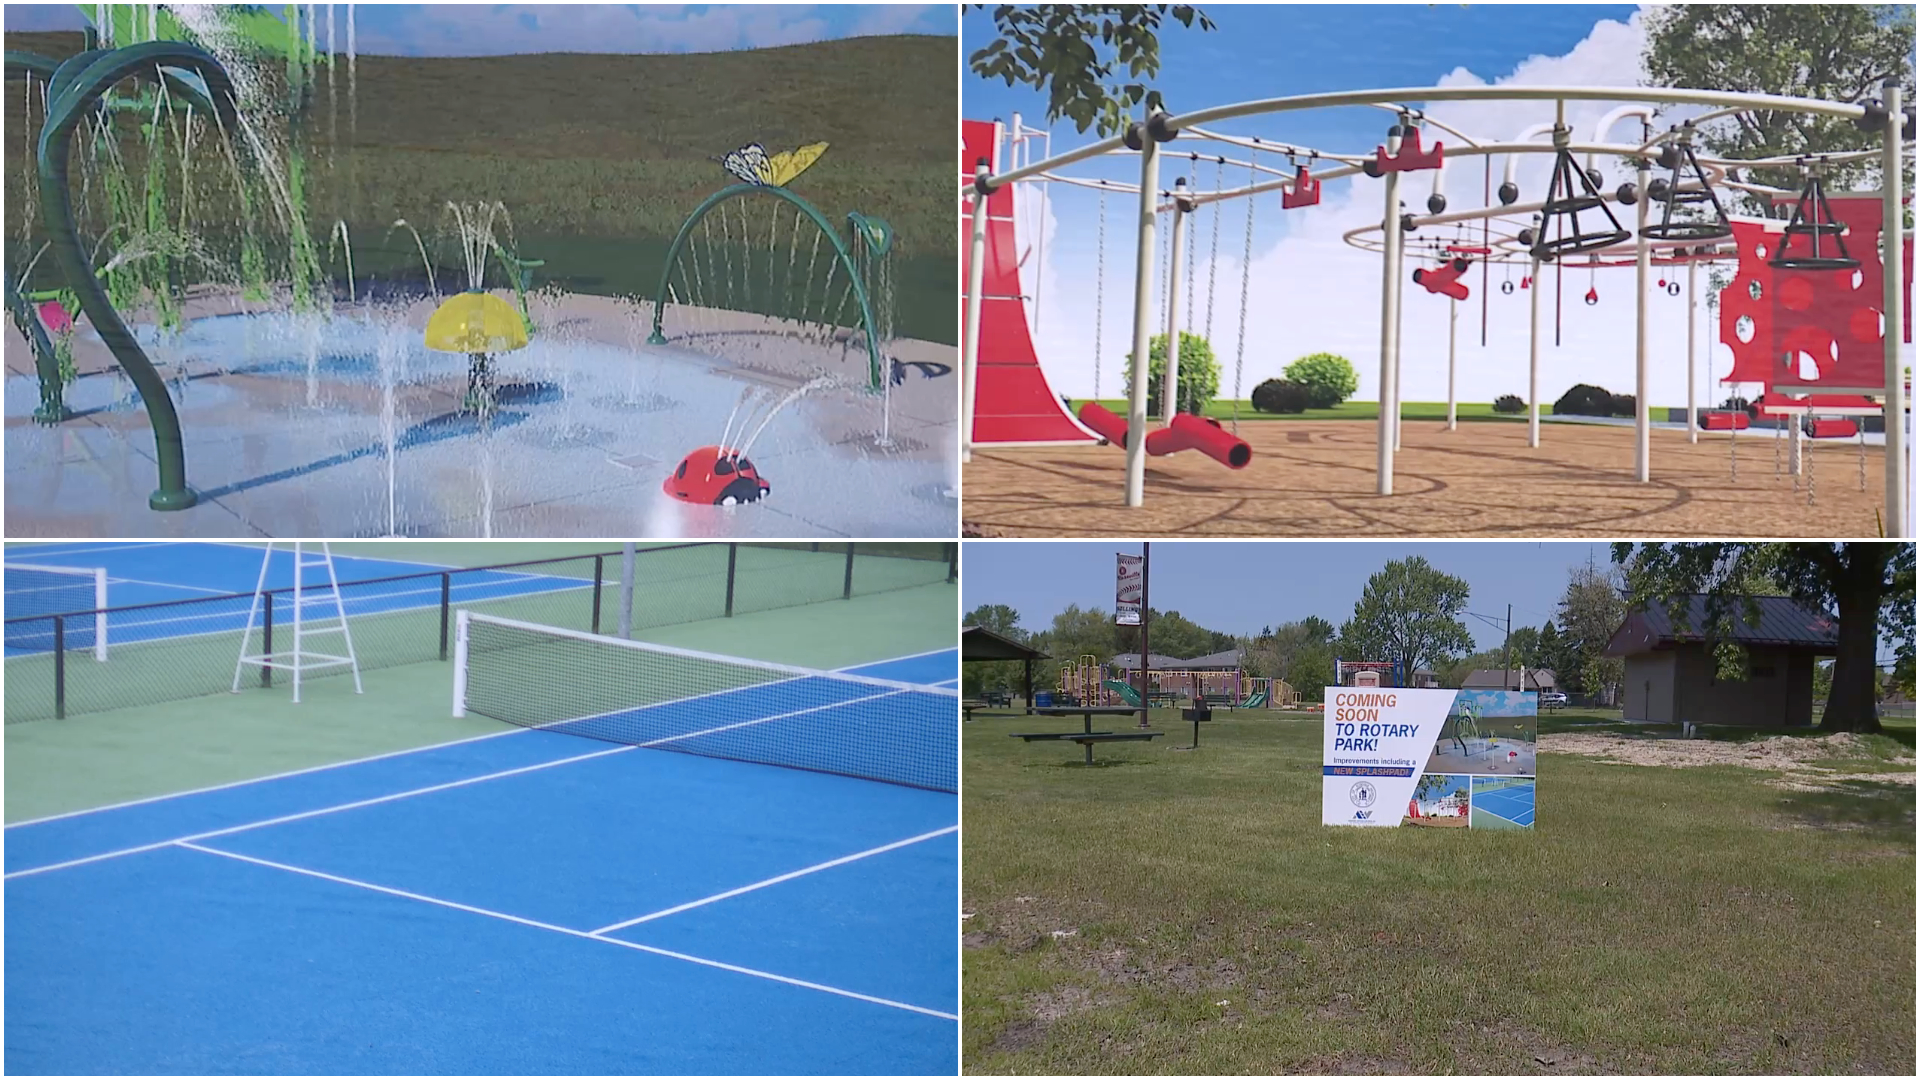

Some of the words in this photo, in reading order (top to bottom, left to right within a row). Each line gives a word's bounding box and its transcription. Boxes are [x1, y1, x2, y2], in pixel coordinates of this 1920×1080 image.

[1336, 693, 1397, 707] COMING
[1335, 708, 1379, 722] SOON
[1336, 723, 1355, 736] TO
[1359, 723, 1419, 738] ROTARY
[1334, 738, 1378, 751] PARK!
[1333, 757, 1379, 765] Improvements
[1381, 758, 1410, 766] including
[1333, 767, 1354, 775] NEW
[1355, 767, 1410, 776] SPLASHPAD!
